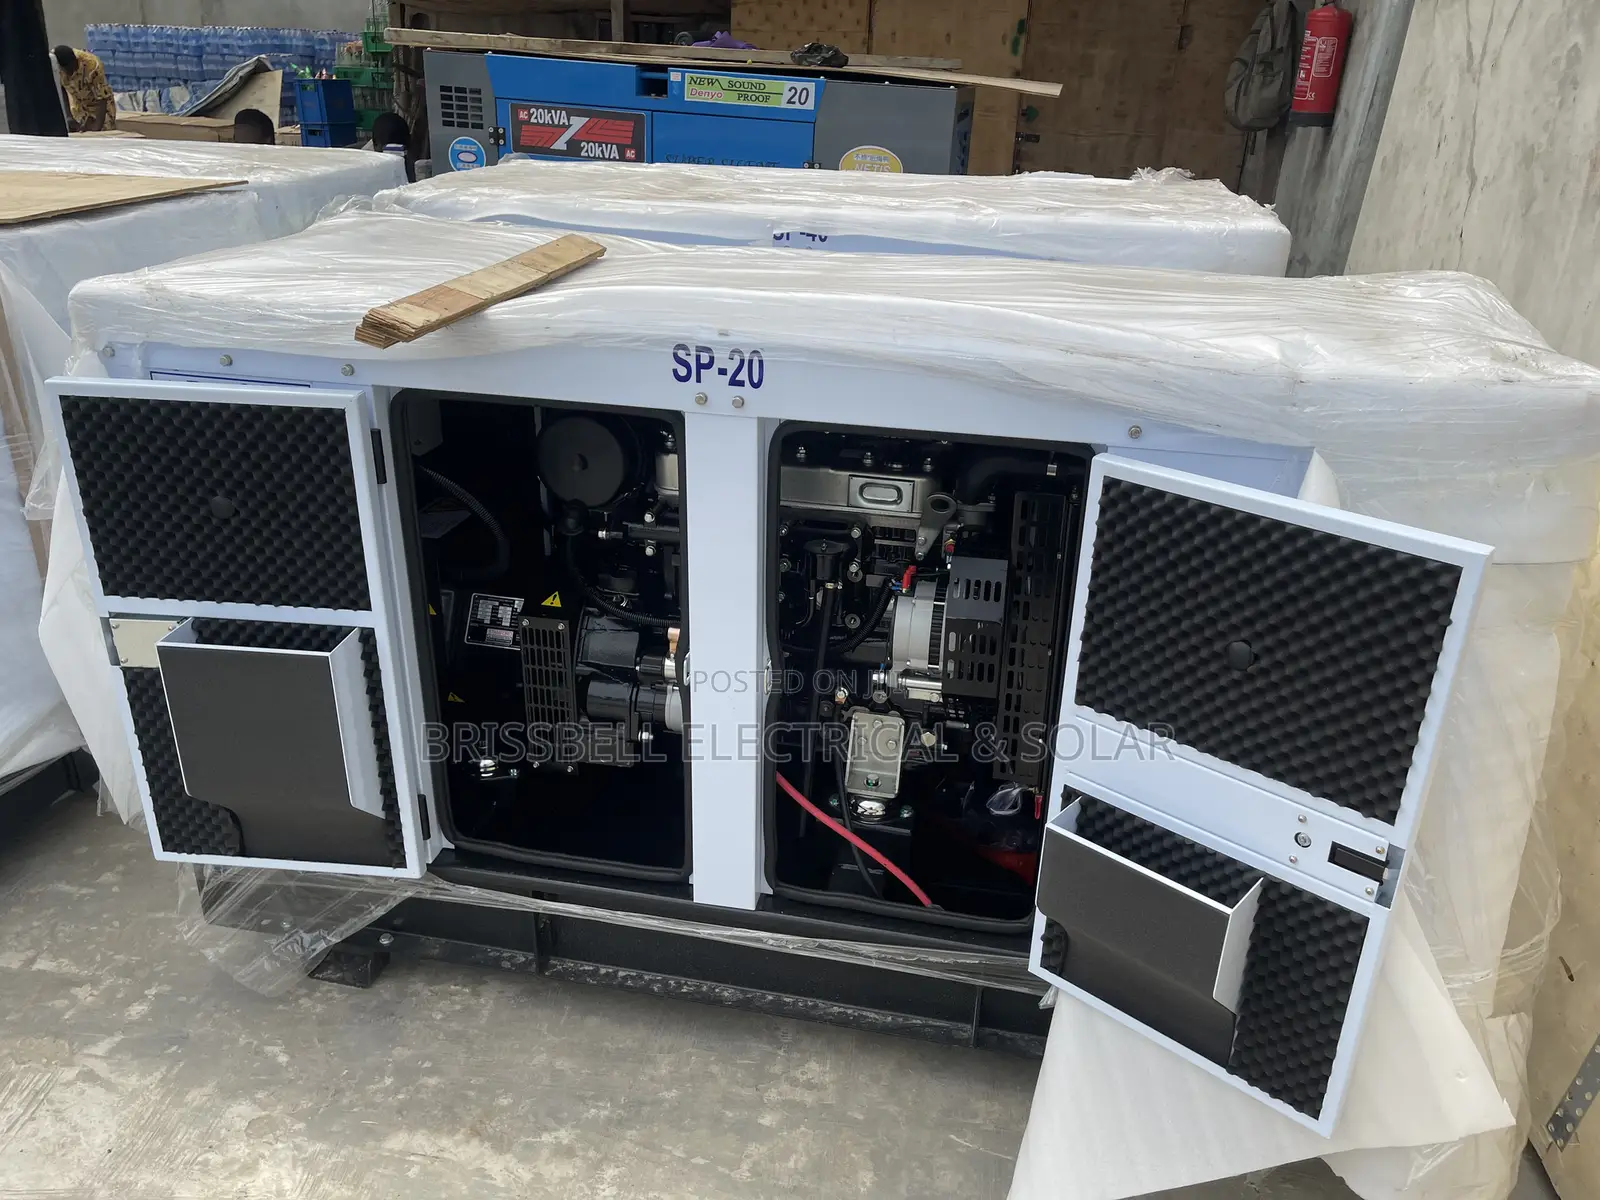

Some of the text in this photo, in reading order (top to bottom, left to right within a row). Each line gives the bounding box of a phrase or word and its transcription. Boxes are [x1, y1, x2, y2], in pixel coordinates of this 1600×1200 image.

[688, 76, 716, 87] NEW
[727, 80, 766, 90] SOUND
[689, 87, 771, 103] Denyo PROOF
[786, 86, 810, 105] 20
[519, 107, 569, 126] AC 20kVA
[580, 141, 636, 160] 20kVA AC
[672, 343, 764, 390] SP-20
